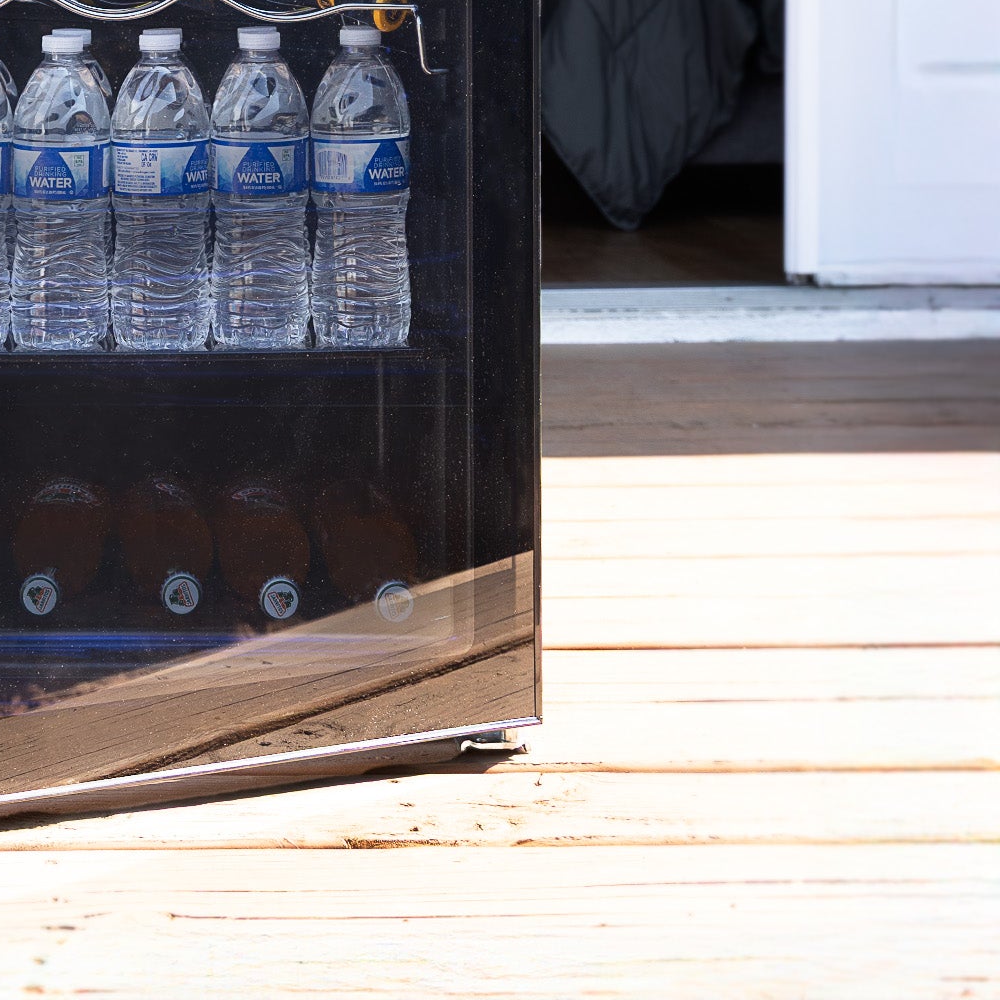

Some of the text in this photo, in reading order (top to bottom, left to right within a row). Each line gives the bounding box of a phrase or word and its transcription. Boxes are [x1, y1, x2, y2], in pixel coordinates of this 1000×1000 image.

[237, 172, 281, 184] WATER
[368, 167, 405, 180] WATER
[29, 176, 72, 188] WATER
